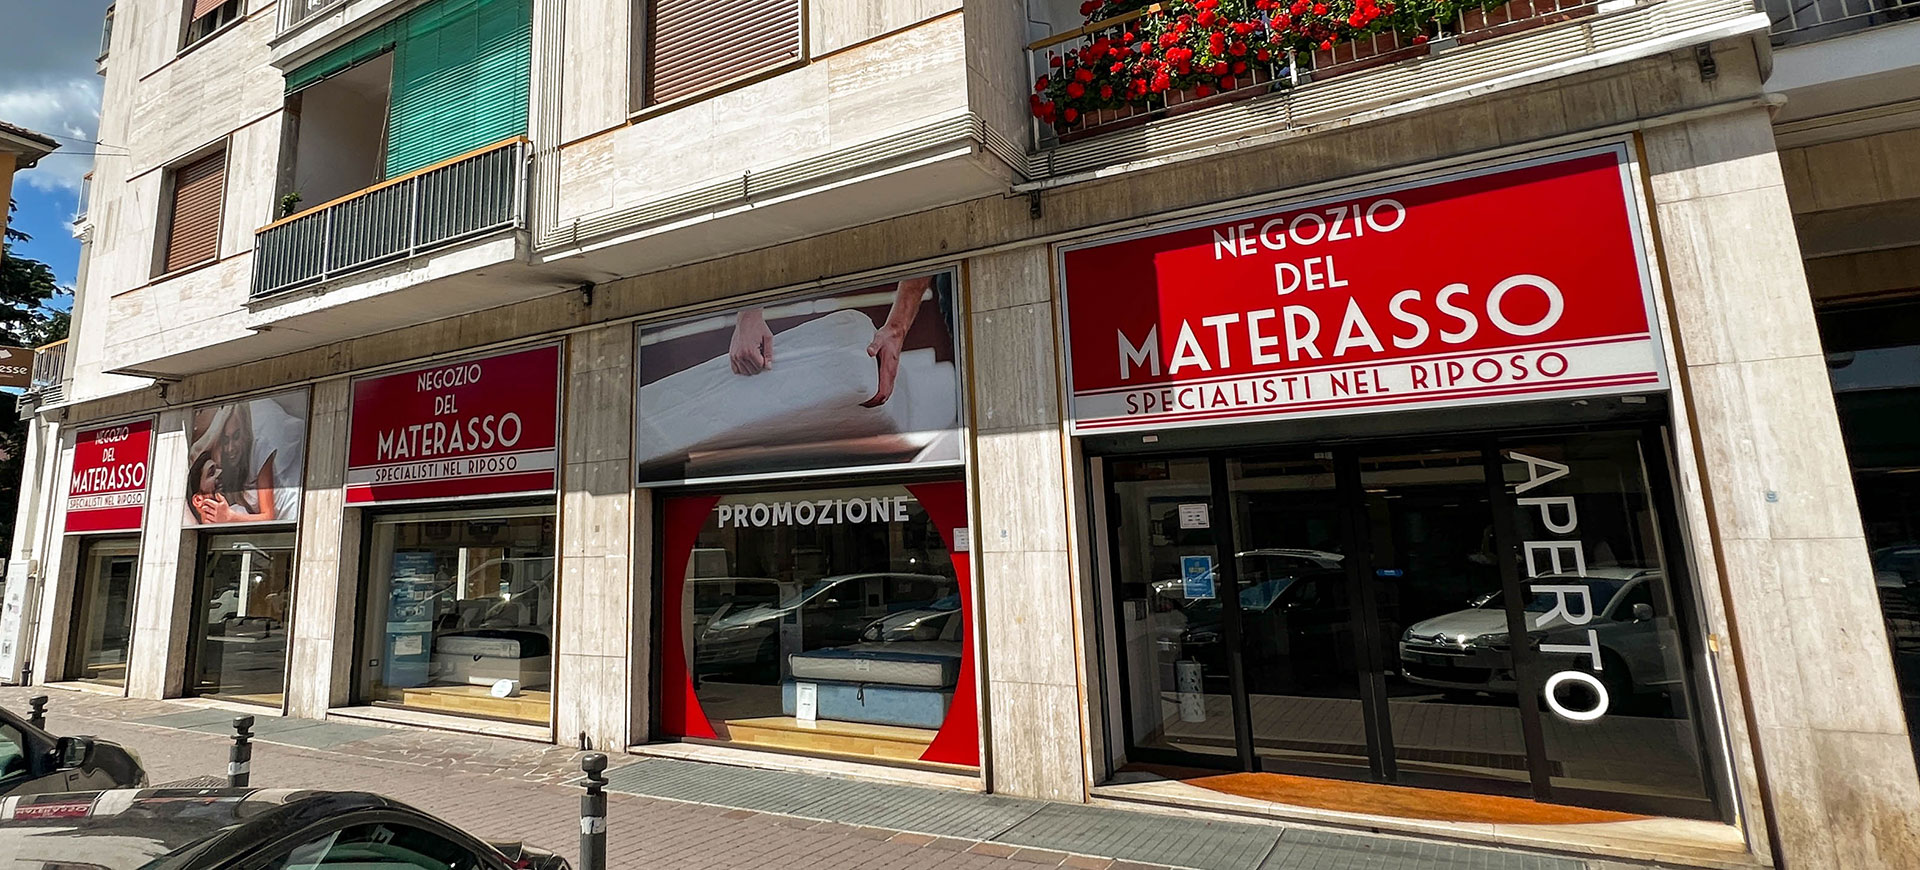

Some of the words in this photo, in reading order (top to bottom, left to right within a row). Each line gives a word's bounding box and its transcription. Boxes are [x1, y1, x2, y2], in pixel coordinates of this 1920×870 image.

[1212, 198, 1406, 261] NEGOZIO
[1274, 254, 1348, 296] DEL
[1117, 273, 1565, 380] MATERASSO
[417, 363, 482, 393] NEGOZIO
[1125, 374, 1311, 416] SPECIALISTI
[1331, 367, 1390, 397] NEL
[1411, 351, 1569, 390] RIPOSO
[434, 394, 458, 416] DEL
[95, 426, 129, 446] NEGOZIO
[377, 411, 522, 461] MATERASSO
[102, 447, 116, 463] DEL
[375, 463, 438, 482] SPECIALISTI
[443, 461, 462, 477] NEL
[468, 456, 517, 475] RIPOSO
[70, 462, 146, 494] MATERASSO
[70, 497, 103, 509] SPECIALISTI
[104, 496, 115, 506] NEL
[117, 493, 142, 504] RIPOSO
[718, 495, 910, 528] PROMOZIONE
[1509, 451, 1610, 721] APERTO
